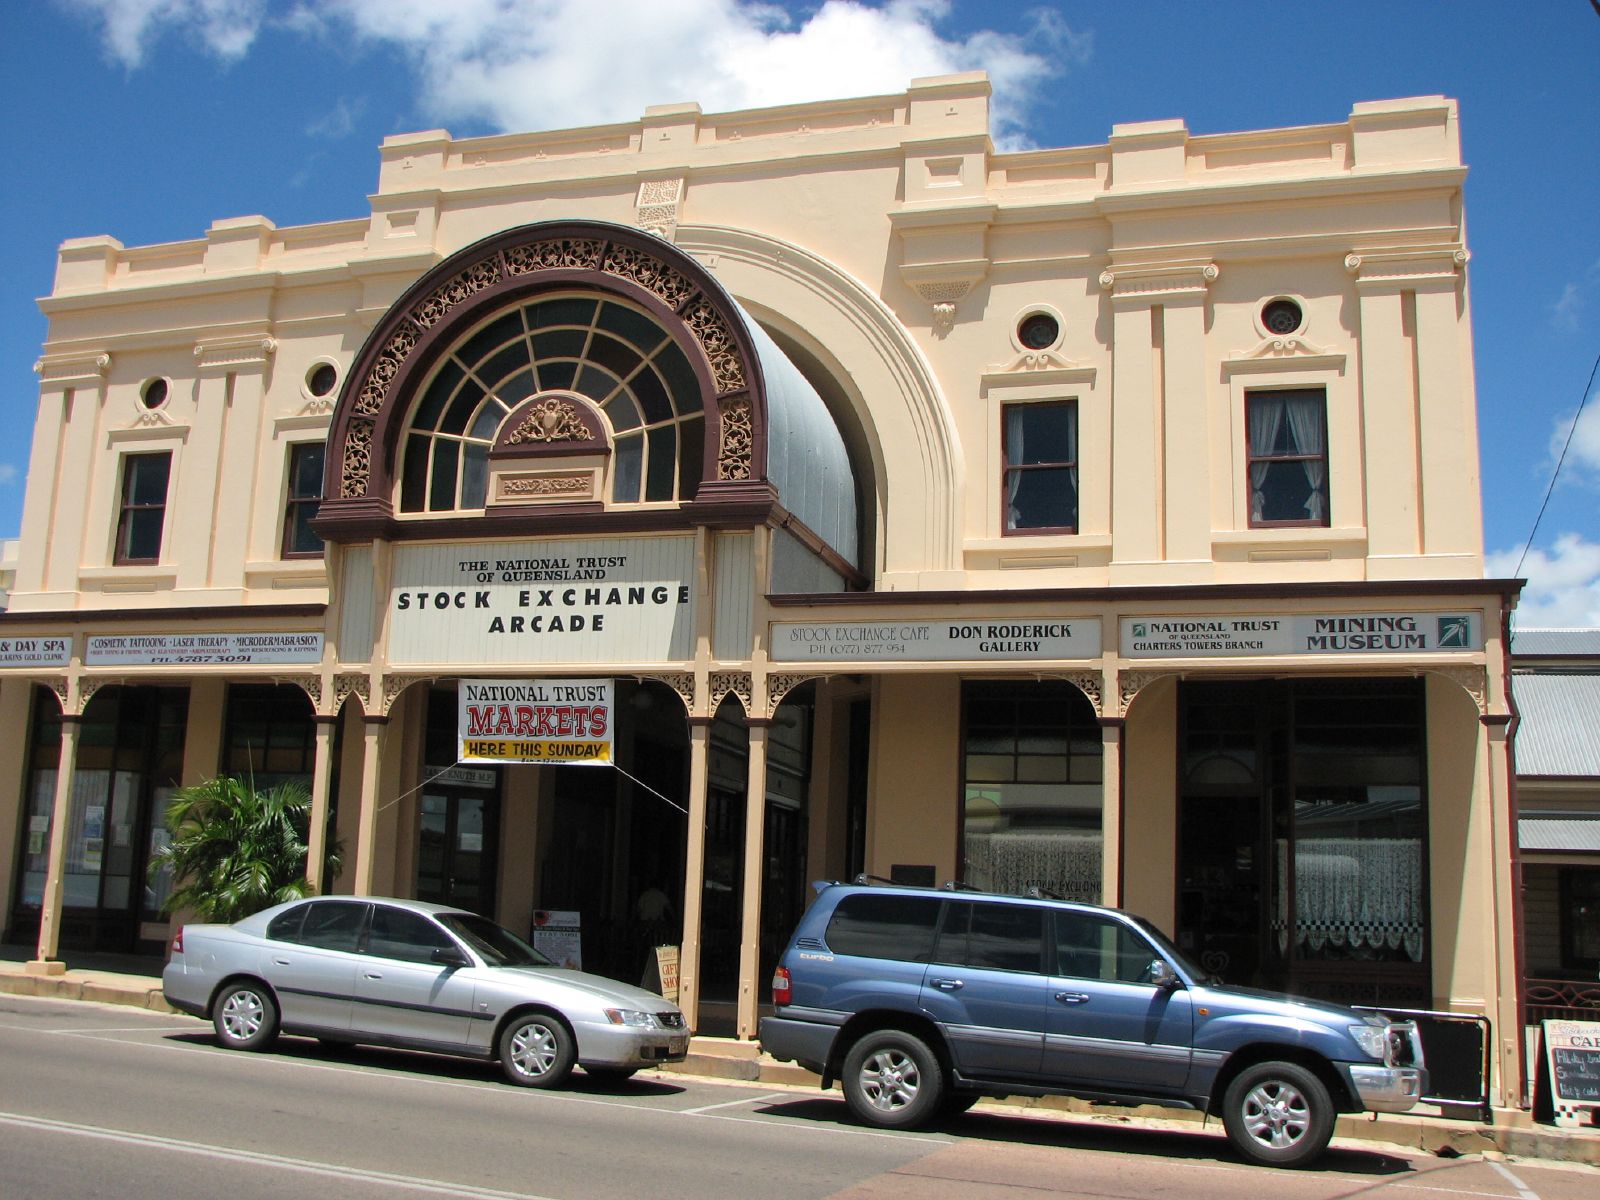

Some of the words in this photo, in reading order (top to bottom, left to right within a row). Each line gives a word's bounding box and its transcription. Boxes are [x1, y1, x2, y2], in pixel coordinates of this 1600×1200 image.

[459, 561, 489, 571] THE
[495, 559, 570, 571] NATIONAL
[577, 556, 627, 568] TRUST
[476, 572, 495, 582] OF
[502, 569, 606, 582] QUEENSLAND
[397, 591, 491, 610] STOCK
[519, 586, 689, 607] EXCHANGE
[488, 614, 604, 633] ARCADE
[1150, 621, 1226, 632] NATIONAL
[1231, 620, 1280, 631] TRUST
[1314, 616, 1417, 634] MINING
[790, 626, 831, 642] STOCK
[836, 626, 897, 641] EXCHANGE
[900, 626, 930, 641] CAFE
[949, 626, 982, 639] DON
[987, 624, 1072, 639] RODERICK
[1, 641, 11, 652] &
[15, 641, 38, 652] DAY
[43, 640, 65, 651] SPA
[94, 638, 127, 648] COSMETIC
[130, 638, 167, 648] TATTOOING
[173, 638, 194, 646] LASER
[198, 637, 228, 646] THERAPY
[236, 635, 318, 646] MICRODERMABRASION
[979, 641, 1041, 653] GALLERY
[1133, 641, 1182, 651] CHARTERS
[1184, 641, 1223, 650] TOWERS
[1225, 640, 1263, 650] BRANCH
[1306, 633, 1427, 650] MUSEUM
[809, 644, 826, 654] PH
[830, 644, 861, 655] (077)
[864, 644, 882, 654] 877
[44, 653, 63, 661] CLINIC
[175, 655, 212, 663] 4787
[466, 685, 549, 702] NATIONAL
[553, 685, 606, 702] TRUST
[466, 704, 608, 738] MARKETS
[469, 742, 506, 755] HERE
[513, 743, 542, 756] THIS
[548, 743, 603, 758] SUNDAY
[800, 953, 834, 961] turbo
